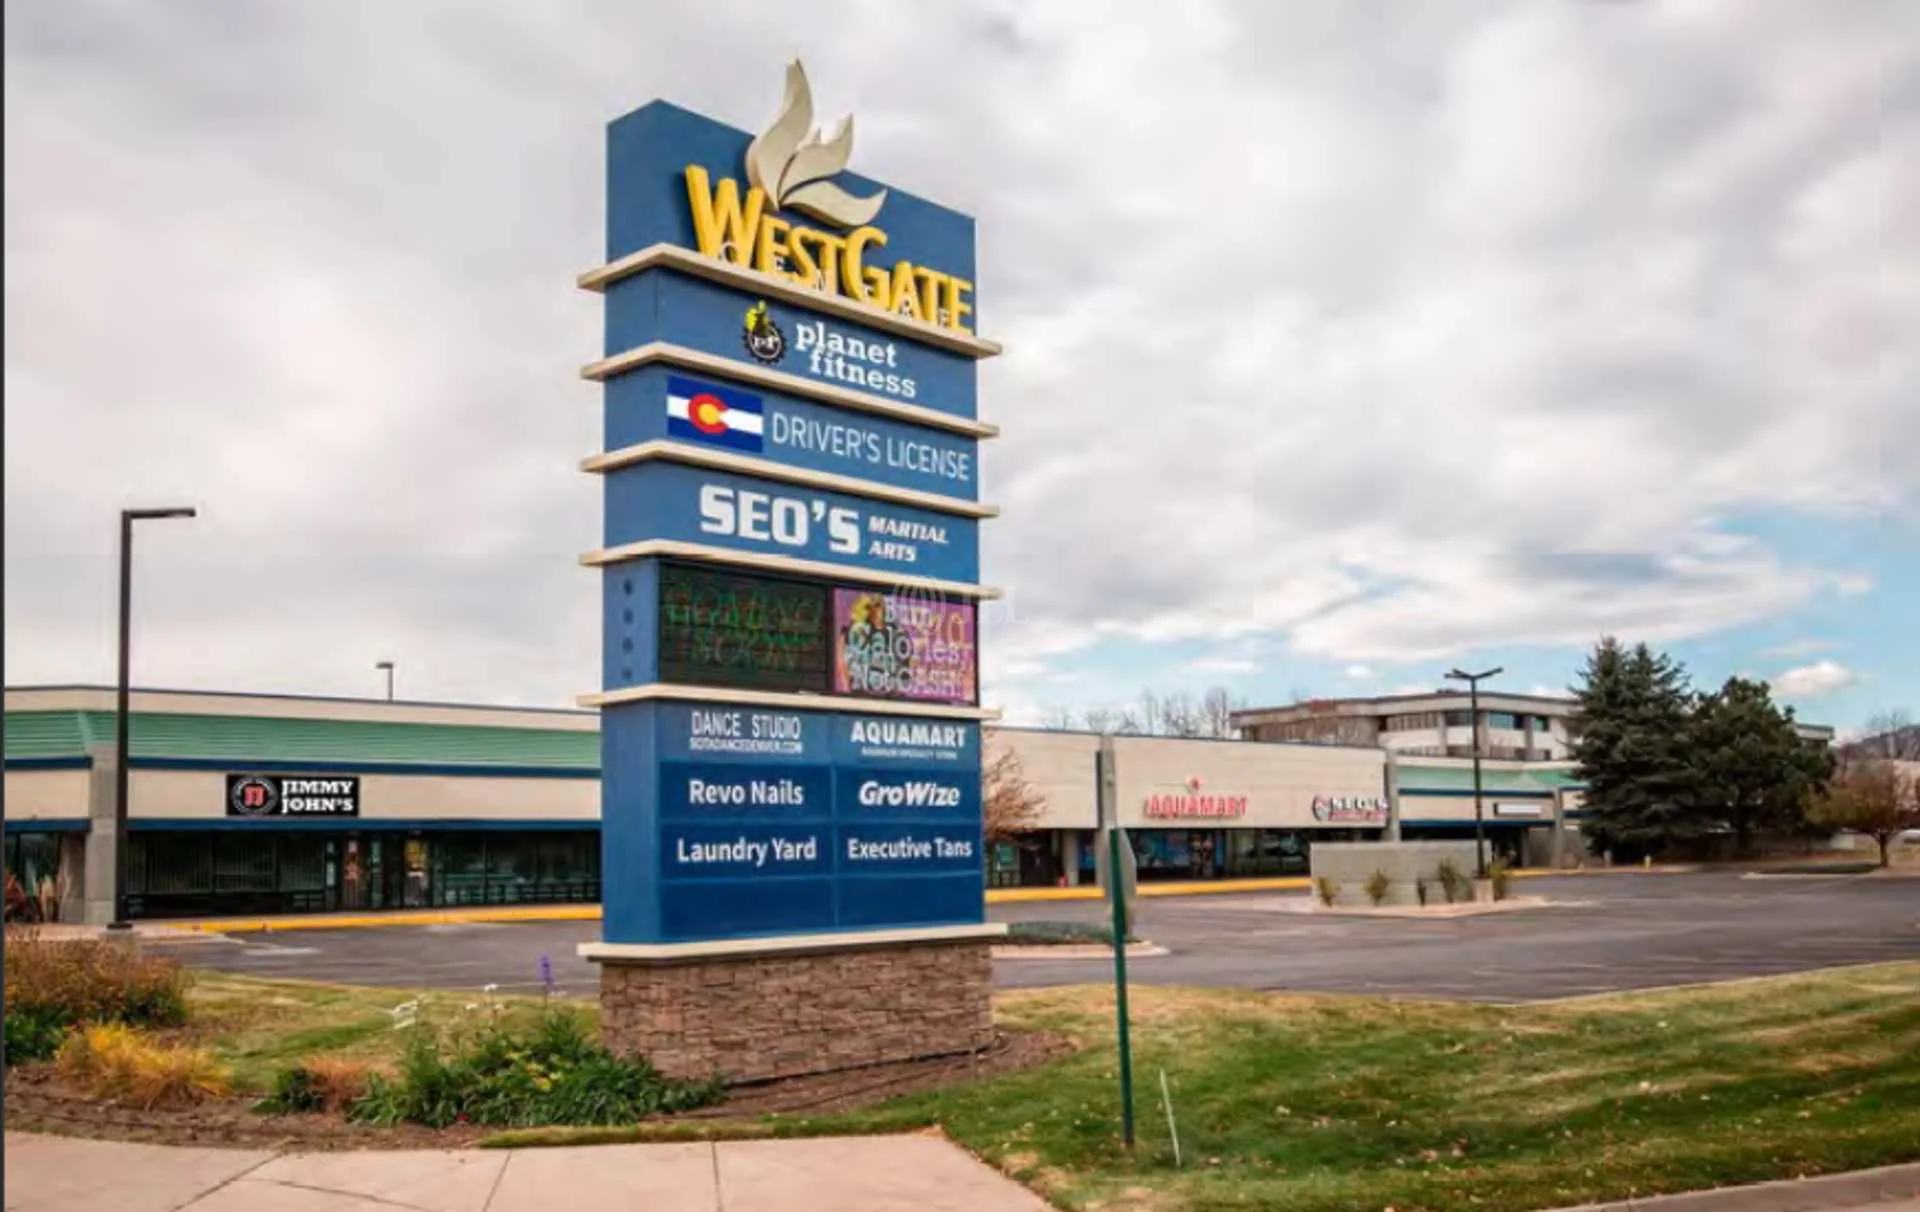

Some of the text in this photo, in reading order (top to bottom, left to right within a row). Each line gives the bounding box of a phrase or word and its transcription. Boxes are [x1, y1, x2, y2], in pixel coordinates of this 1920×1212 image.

[685, 164, 974, 337] WESTGATE
[796, 321, 897, 367] planet
[810, 348, 916, 398] fitness
[772, 412, 970, 481] DRIVER'S LICENSE
[700, 484, 860, 555] SEO'S
[868, 516, 948, 543] MARTIAL
[868, 541, 917, 563] ARTS
[691, 711, 801, 740] DANCE STUDIO
[851, 720, 967, 748] AQUAMART
[282, 780, 353, 797] JIMMY
[689, 780, 804, 805] Revo Nails
[859, 781, 960, 806] GroWize
[282, 797, 354, 814] JOHN'S
[677, 837, 817, 868] Laundry Yard
[847, 837, 973, 859] Executive Tans
